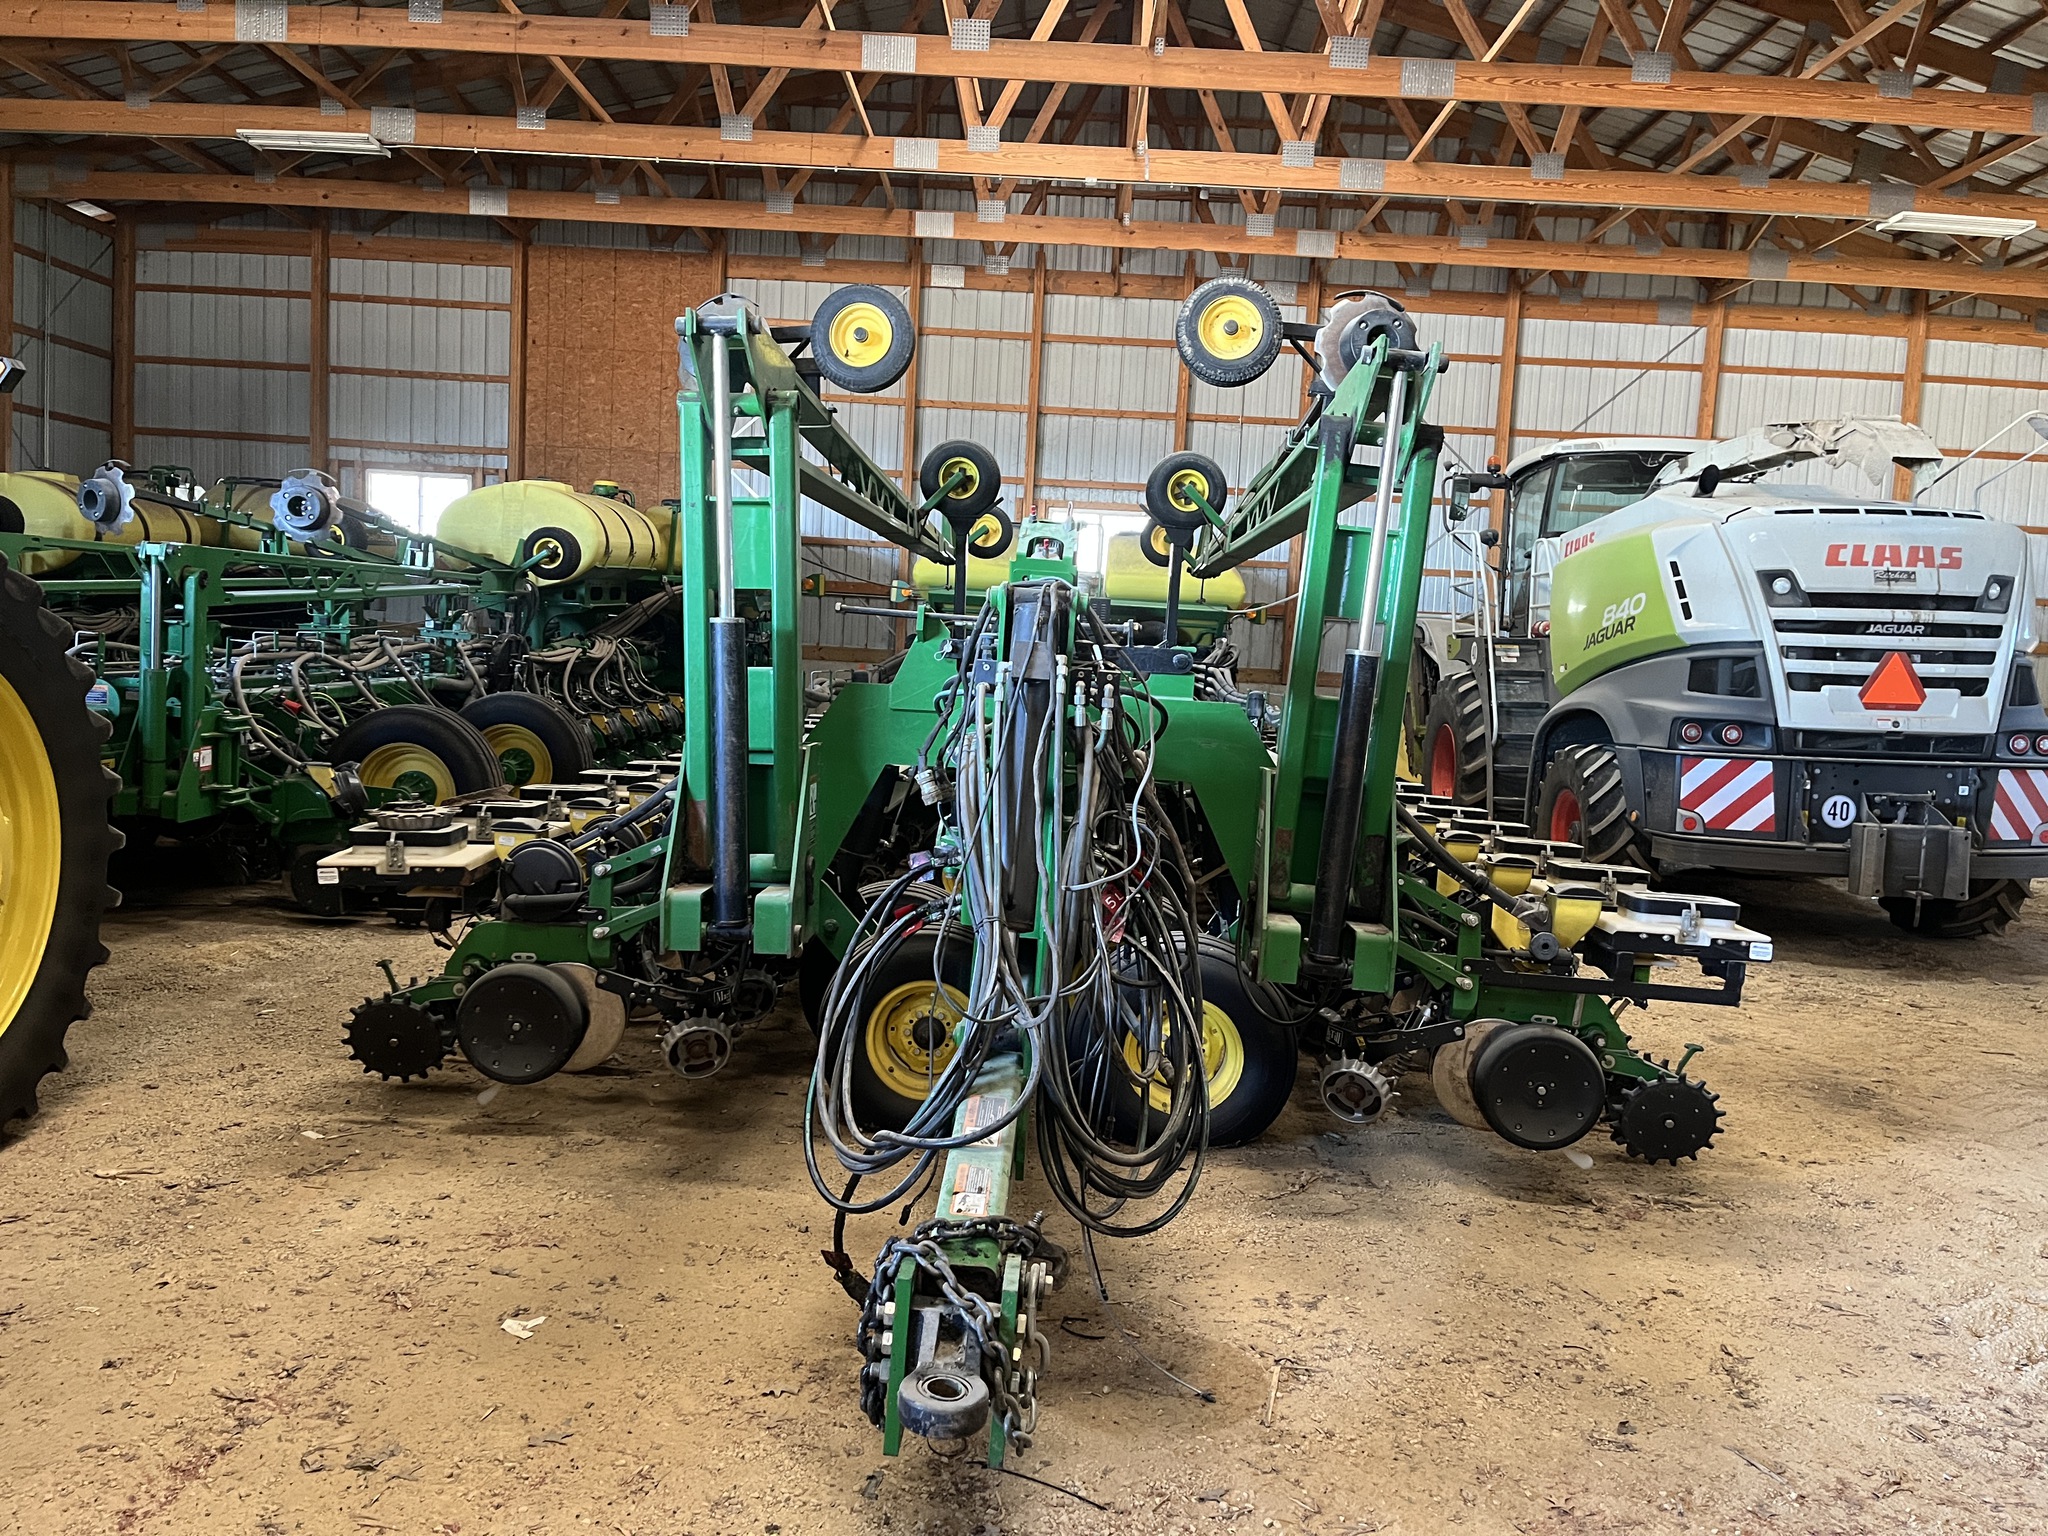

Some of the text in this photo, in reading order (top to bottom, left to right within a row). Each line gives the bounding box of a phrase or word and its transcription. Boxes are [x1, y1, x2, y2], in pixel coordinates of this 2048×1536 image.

[1825, 544, 1963, 570] CLAAS
[1602, 592, 1647, 628] 840
[1583, 616, 1636, 651] JAGUAR
[1866, 623, 1925, 635] JAGUAR
[1827, 800, 1850, 822] 40
